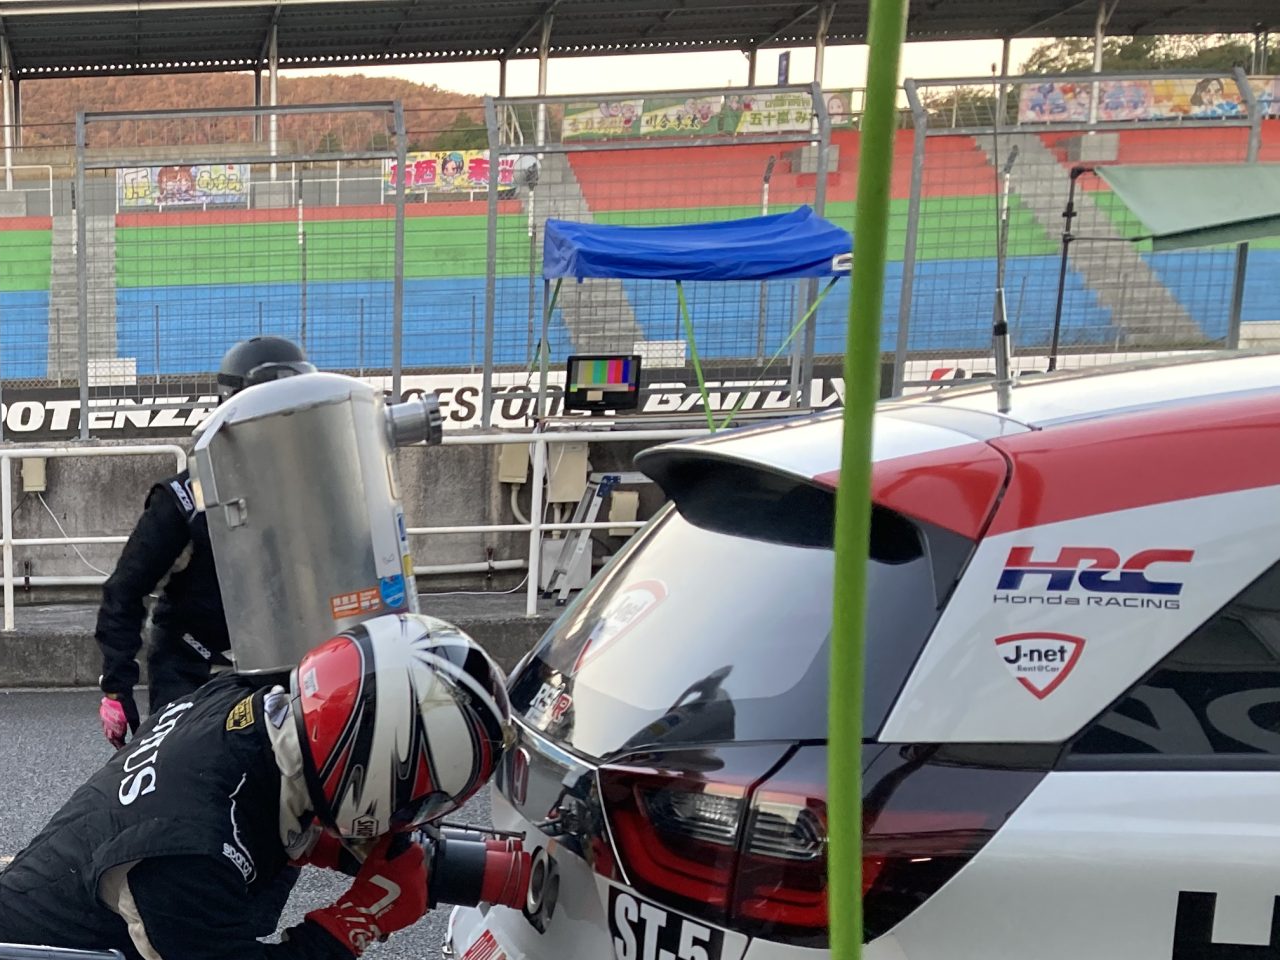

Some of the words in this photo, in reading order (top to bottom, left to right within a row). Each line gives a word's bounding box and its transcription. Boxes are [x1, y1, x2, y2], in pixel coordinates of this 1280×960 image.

[996, 546, 1195, 595] HRC
[993, 594, 1080, 606] Honda
[1087, 596, 1180, 610] RACING
[1004, 645, 1067, 665] J-net
